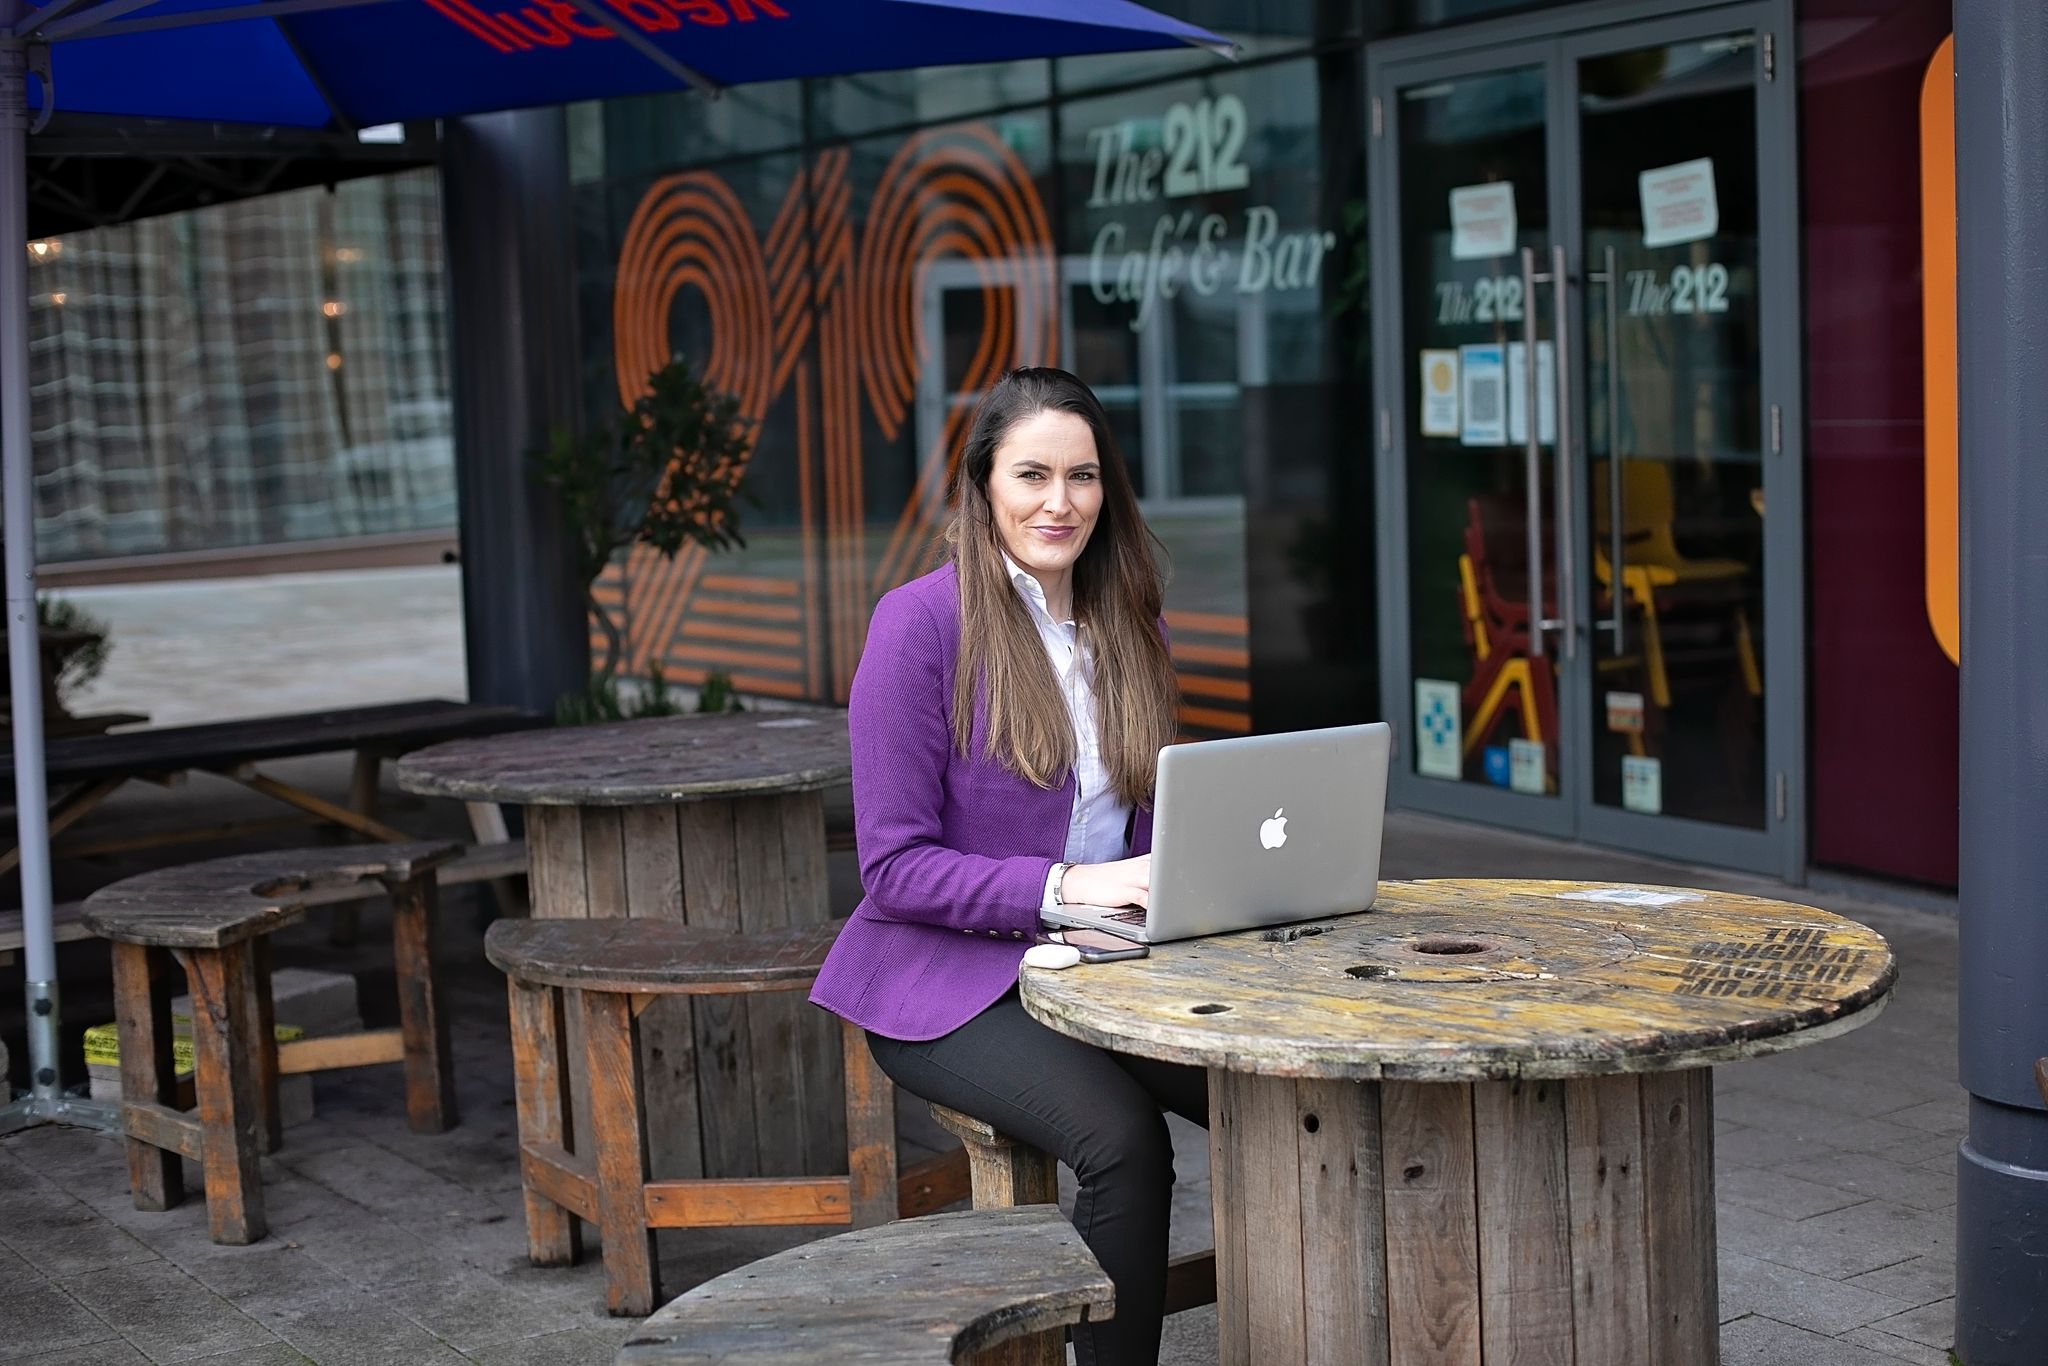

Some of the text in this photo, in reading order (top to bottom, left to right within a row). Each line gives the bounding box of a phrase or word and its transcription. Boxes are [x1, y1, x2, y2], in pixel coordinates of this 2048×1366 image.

[1086, 94, 1249, 208] The 212
[1089, 205, 1336, 333] Café & Bar
[1626, 262, 1730, 317] The 212
[1436, 274, 1525, 325] The 212
[1764, 926, 1830, 945] THE
